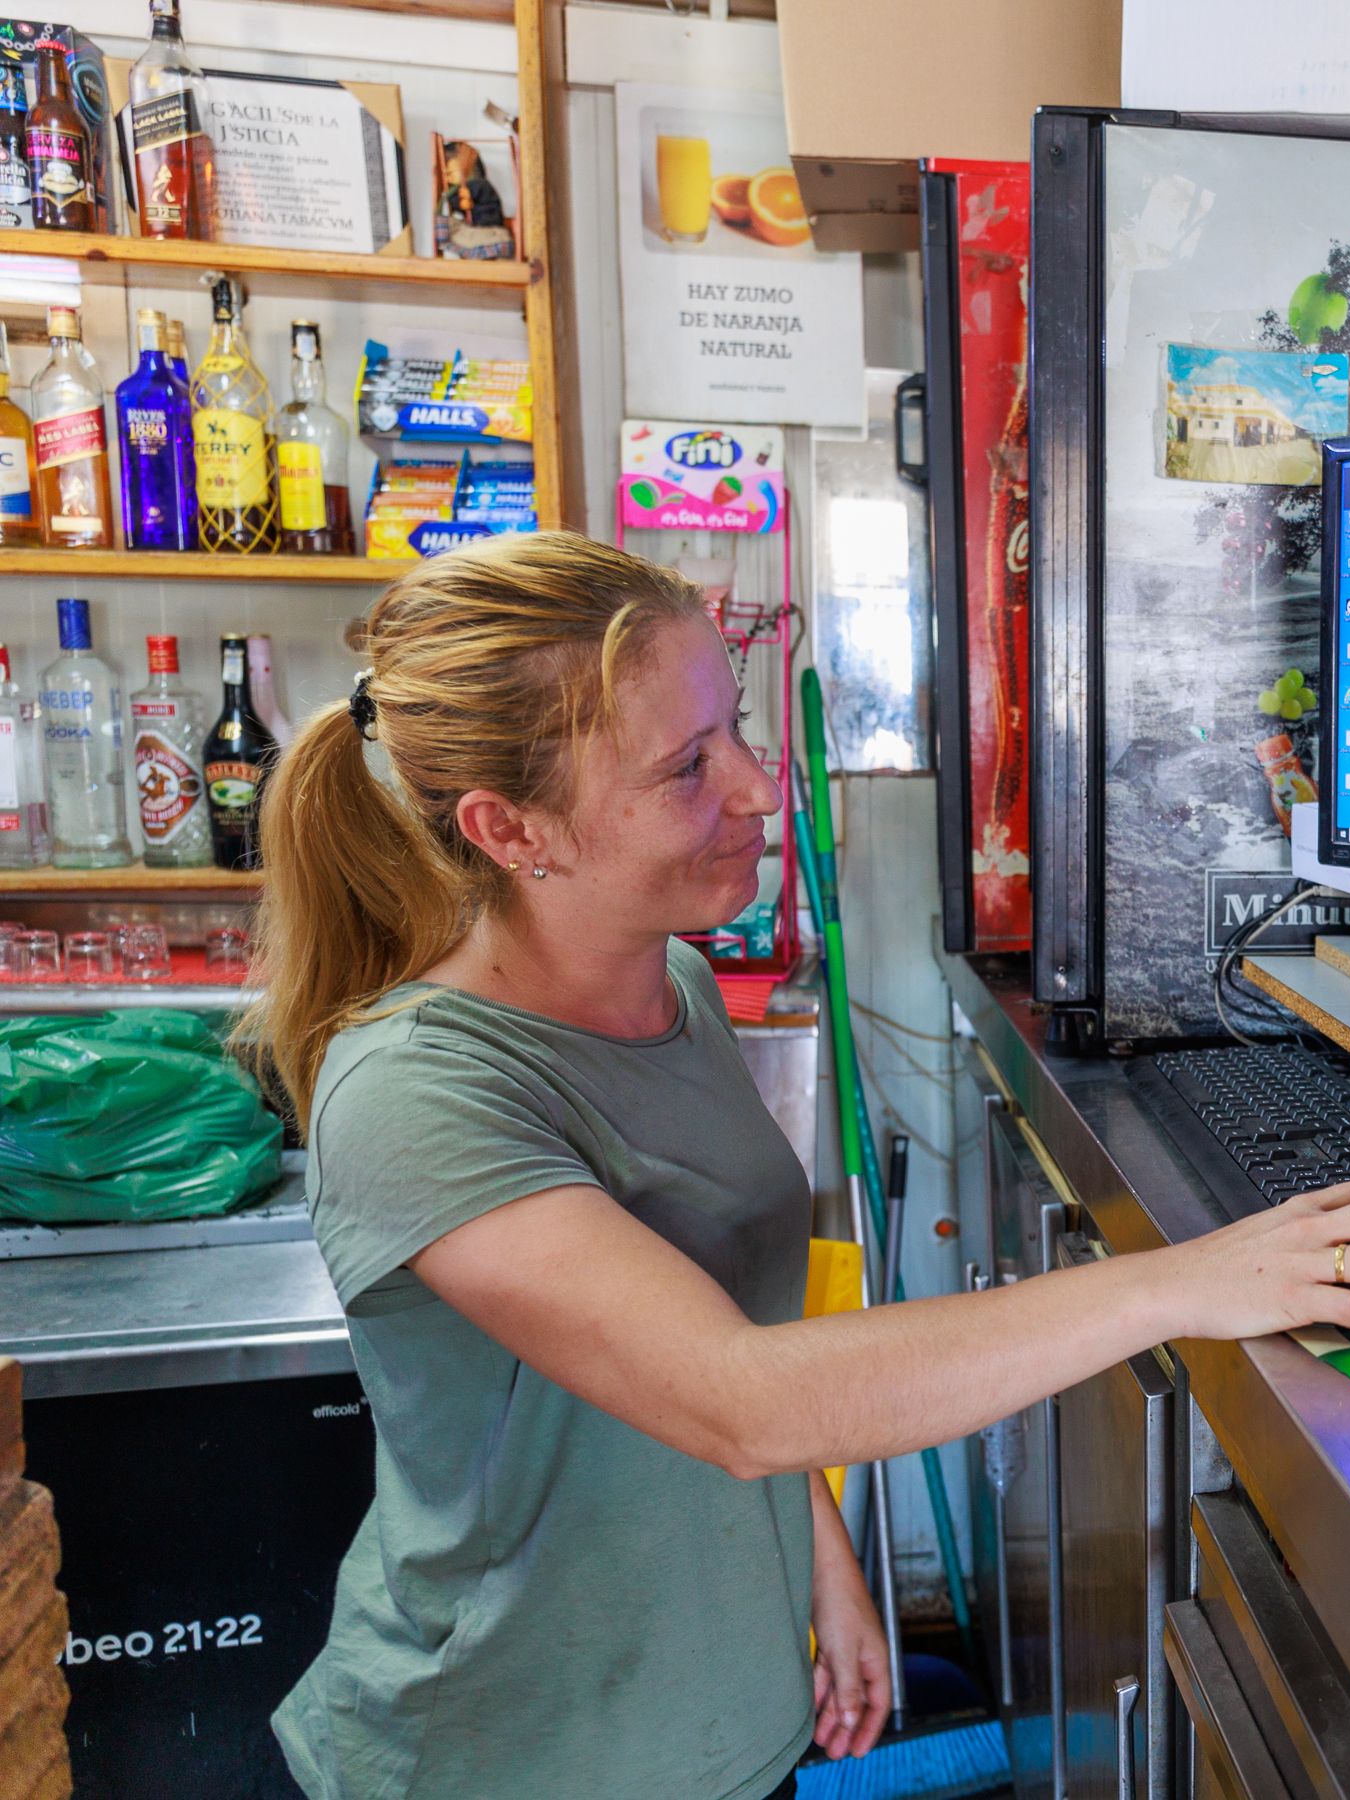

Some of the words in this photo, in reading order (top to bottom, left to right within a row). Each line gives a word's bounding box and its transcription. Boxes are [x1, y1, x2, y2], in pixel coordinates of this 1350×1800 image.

[688, 283, 728, 301] HAY
[734, 285, 794, 304] ZUMO
[680, 311, 708, 328] DE
[713, 313, 803, 336] NARANJA
[700, 340, 792, 359] NATURAL
[409, 406, 478, 427] HALLS
[672, 433, 734, 468] Fini
[312, 1402, 360, 1419] efficold
[54, 1631, 154, 1665] beo
